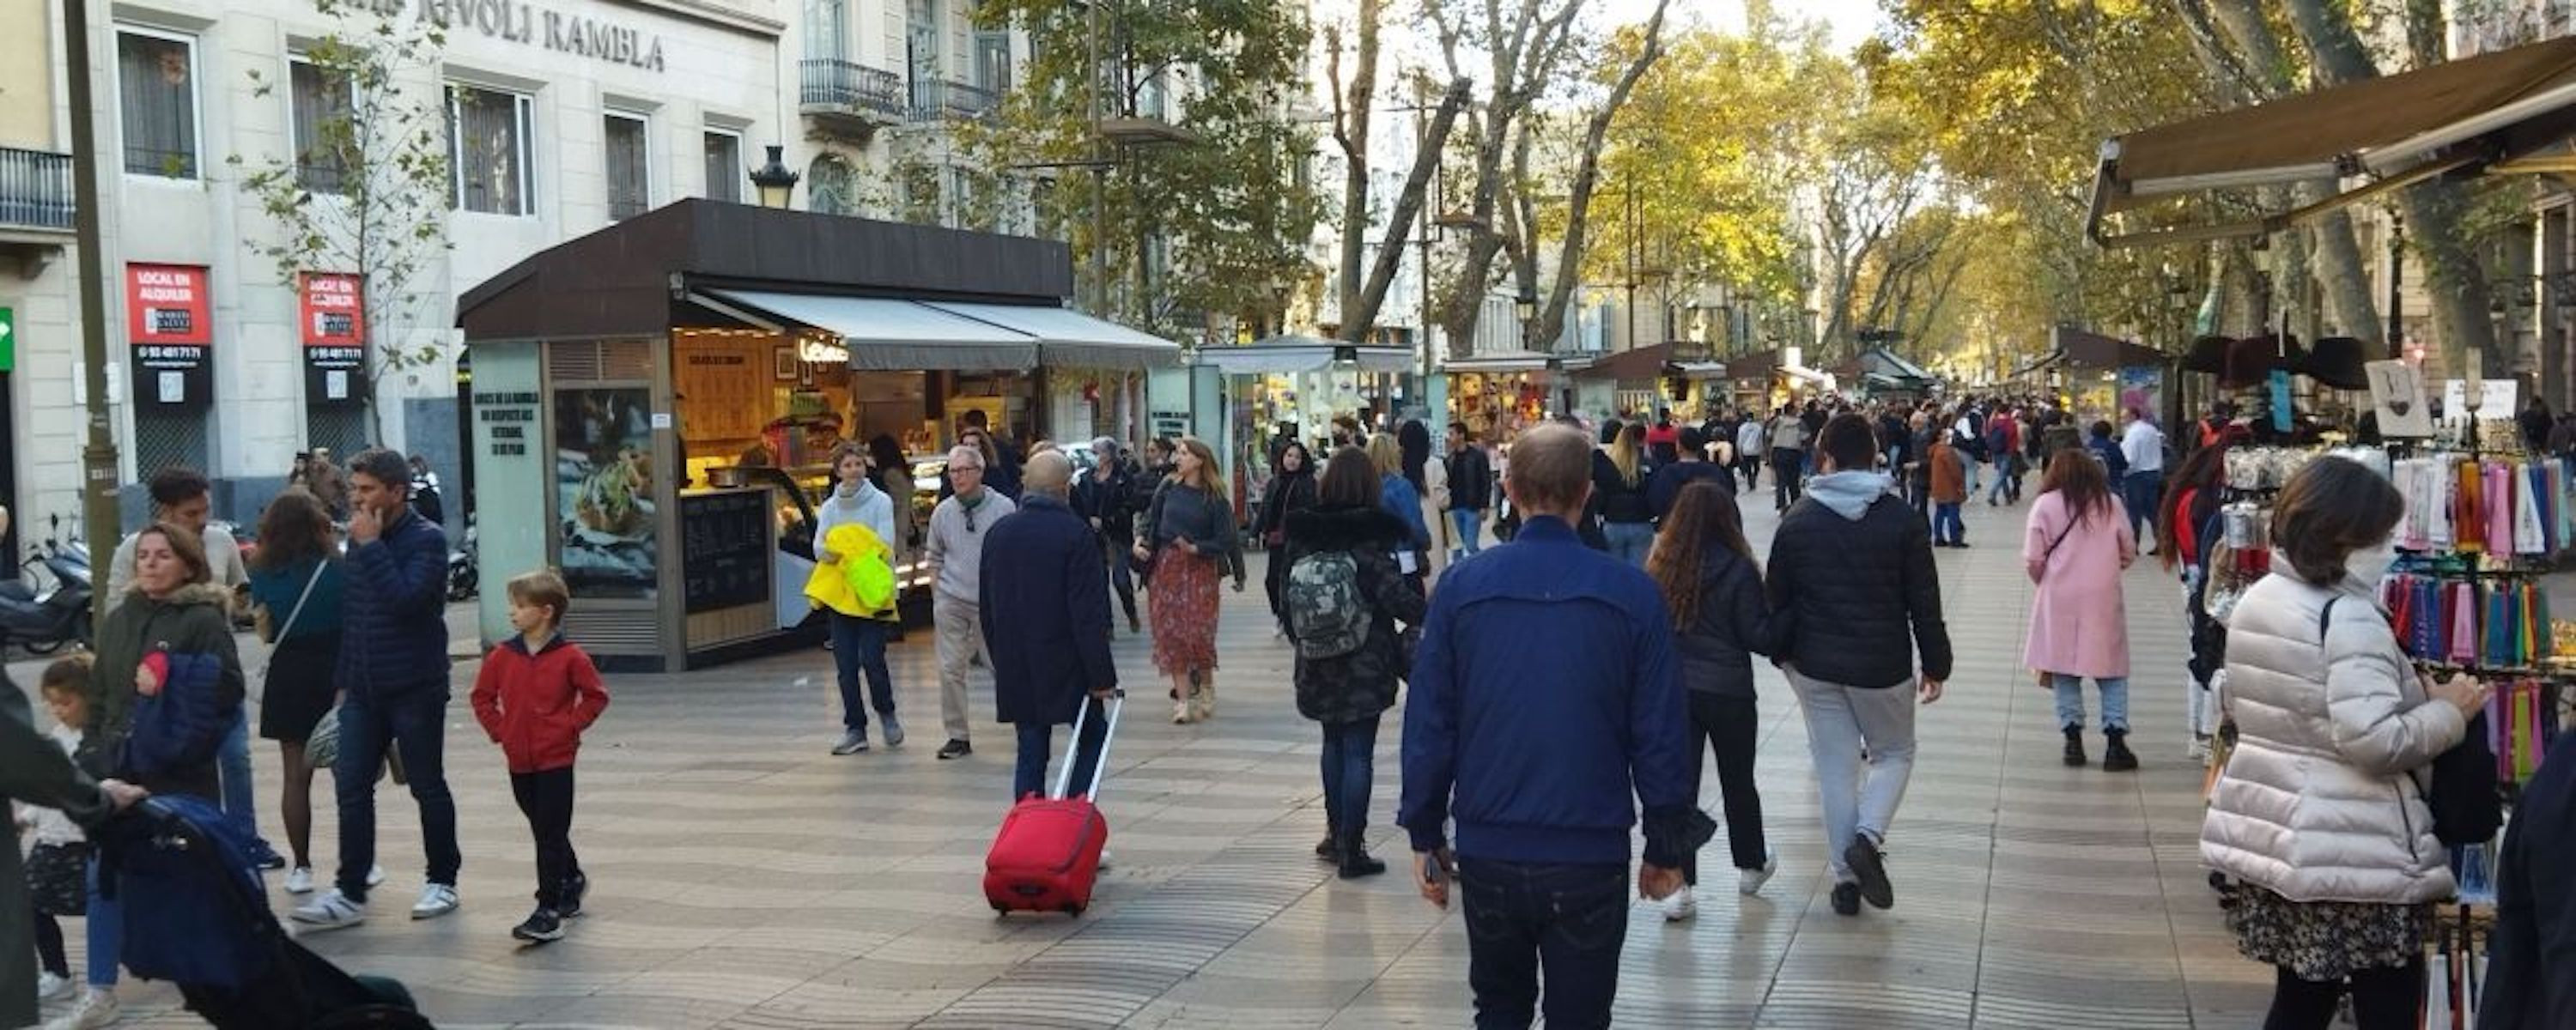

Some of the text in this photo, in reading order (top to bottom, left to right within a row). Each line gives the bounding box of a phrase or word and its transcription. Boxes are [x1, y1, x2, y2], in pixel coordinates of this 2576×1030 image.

[543, 9, 665, 72] RAMBLA
[137, 271, 191, 286] LOCAL EN
[139, 287, 192, 301] ALQUILER
